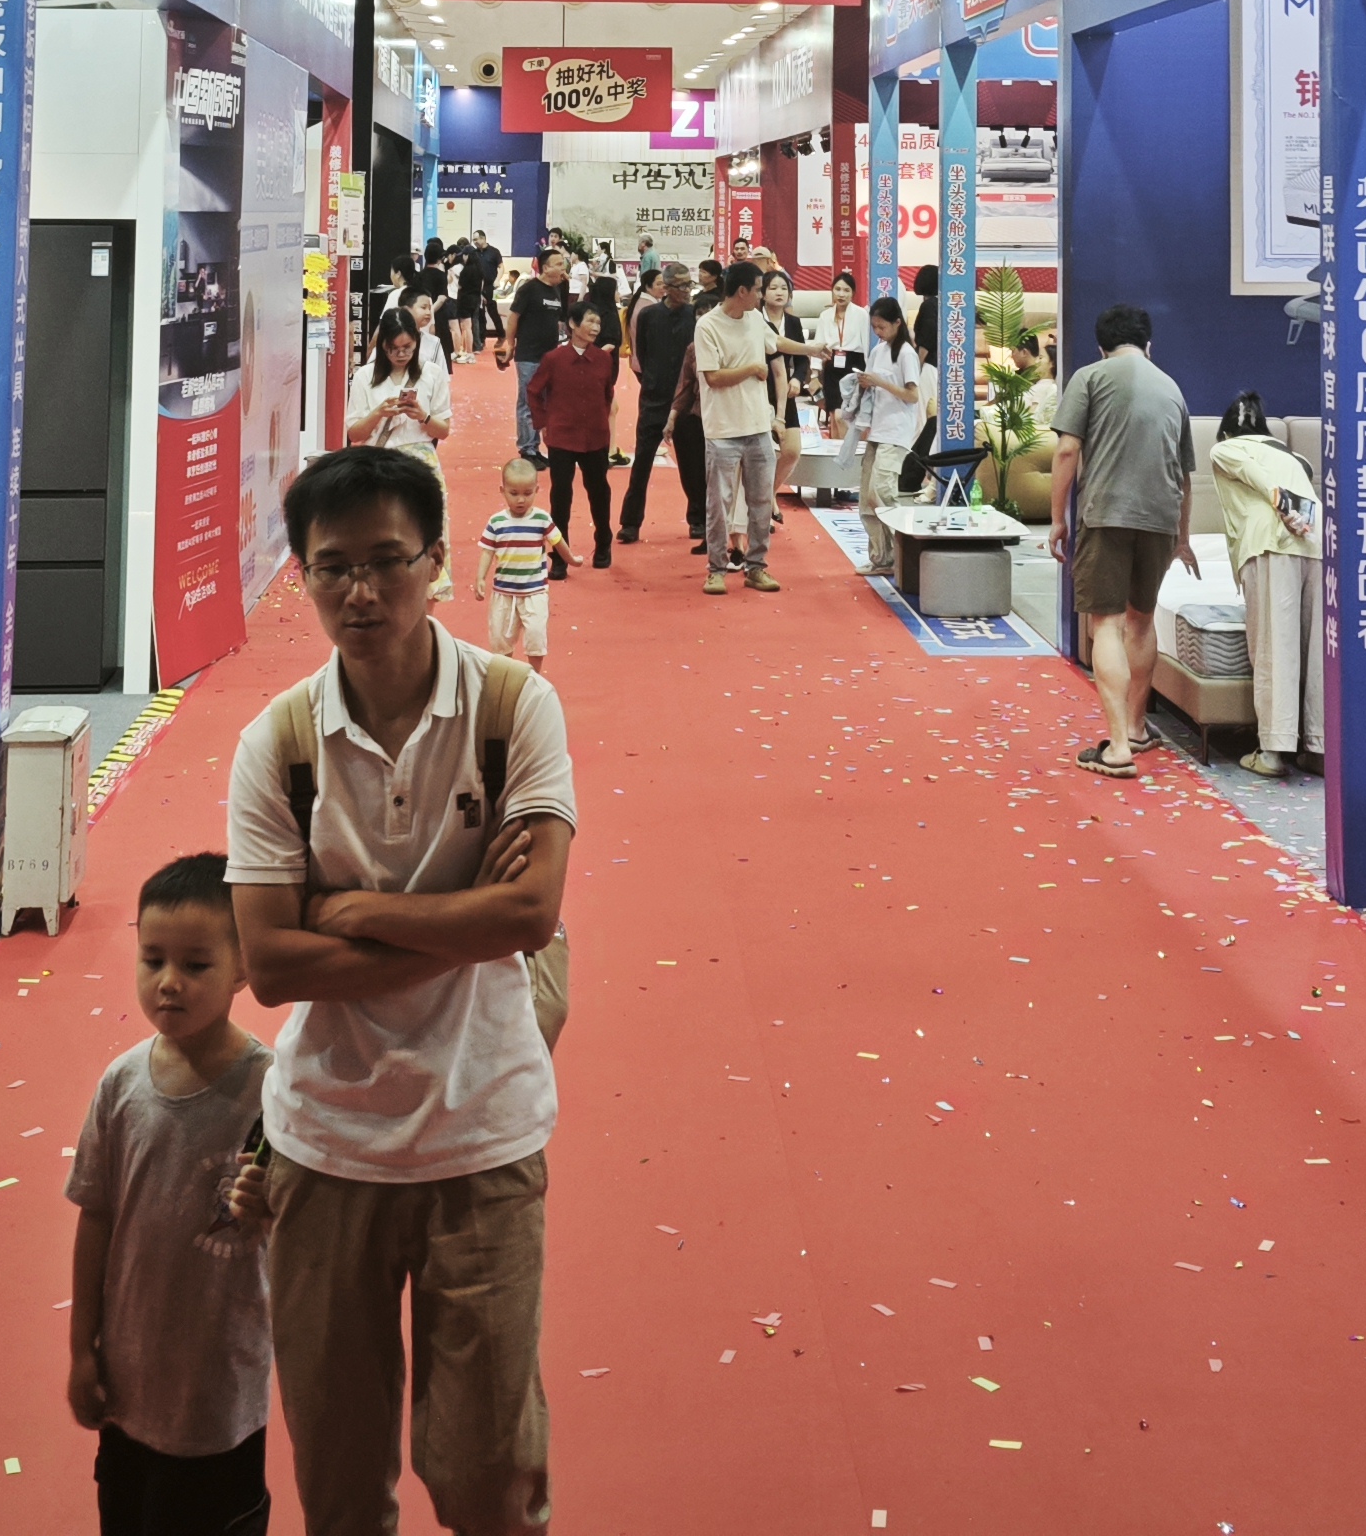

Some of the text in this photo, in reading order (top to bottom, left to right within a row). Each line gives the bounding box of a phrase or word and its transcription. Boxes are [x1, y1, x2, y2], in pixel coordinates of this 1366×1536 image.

[555, 60, 616, 88] 抽好礼
[900, 133, 935, 150] 品质
[898, 162, 934, 180] 套餐
[636, 207, 715, 222] 进口高级红
[946, 164, 967, 275] 坐头等舱沙发
[946, 290, 967, 441] 享头等舱生活方式
